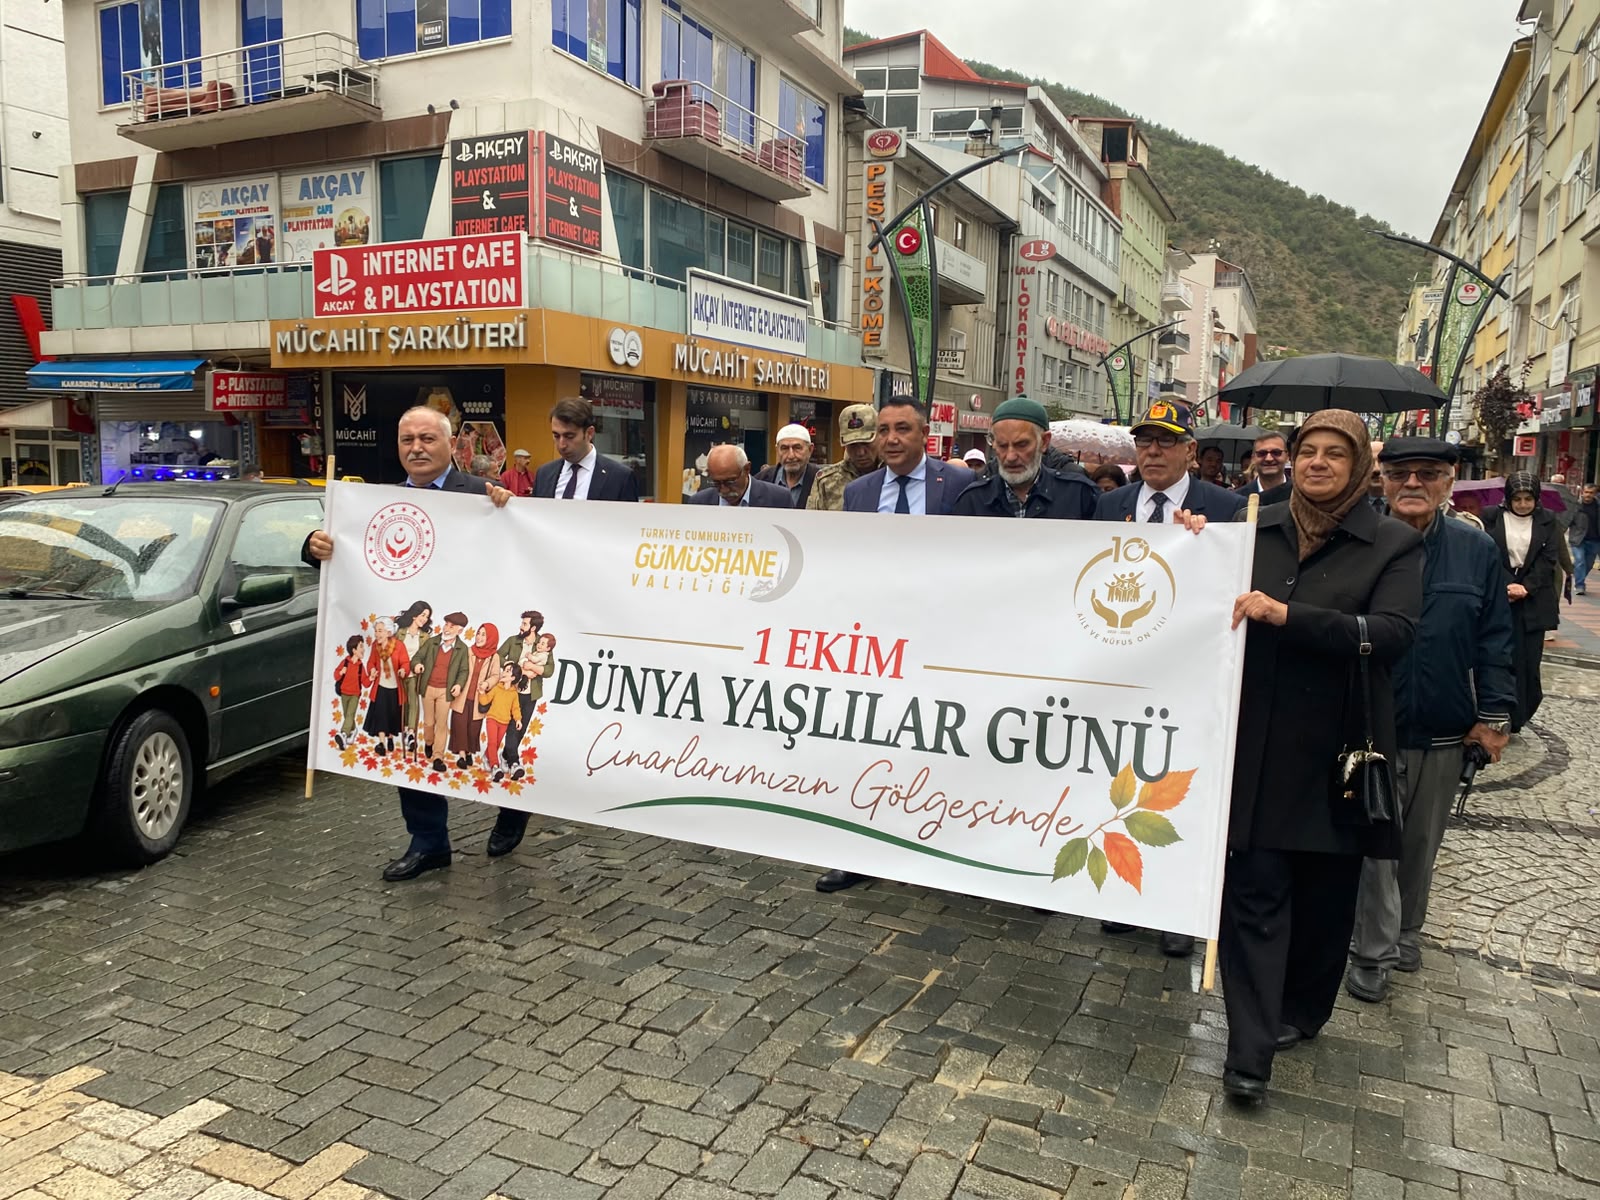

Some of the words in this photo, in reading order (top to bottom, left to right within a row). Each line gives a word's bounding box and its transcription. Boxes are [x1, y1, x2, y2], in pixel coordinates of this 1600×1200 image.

[475, 136, 524, 160] AKÇAY
[563, 146, 599, 175] AKÇAY
[299, 171, 365, 201] AKÇAY
[454, 163, 525, 188] PLAYSTATION
[547, 166, 600, 200] PLAYSTATION
[221, 183, 269, 206] AKÇAY
[482, 190, 496, 210] &
[569, 196, 579, 218] &
[501, 215, 525, 232] CAFE
[583, 228, 600, 248] CAFE
[462, 240, 515, 269] CAFE
[1015, 266, 1035, 275] LALE
[322, 300, 355, 313] AKÇAY
[363, 287, 377, 310] &
[382, 277, 516, 309] PLAYSTATION
[694, 292, 719, 330] AKÇAY
[276, 320, 382, 354] MÜCAHİT
[388, 314, 528, 355] ŞARKÜTERİ
[675, 339, 749, 379] MÜCAHİT
[757, 358, 830, 391] ŞARKÜTERİ
[335, 428, 376, 440] MÜCAHİT
[634, 542, 778, 578] GÜMÜŞHANE
[1090, 629, 1099, 639] VE
[1102, 637, 1133, 646] NÜFUS
[1137, 631, 1151, 642] ON
[1152, 616, 1167, 632] YILI
[753, 627, 772, 665] 1
[784, 622, 909, 679] EKİM
[550, 649, 705, 723] DÜNYA
[721, 676, 970, 758] YAŞLILAR
[986, 695, 1179, 783] GÜNÜ
[586, 721, 839, 796] Çınarlarımızın
[850, 759, 1084, 848] Gölgesinde
